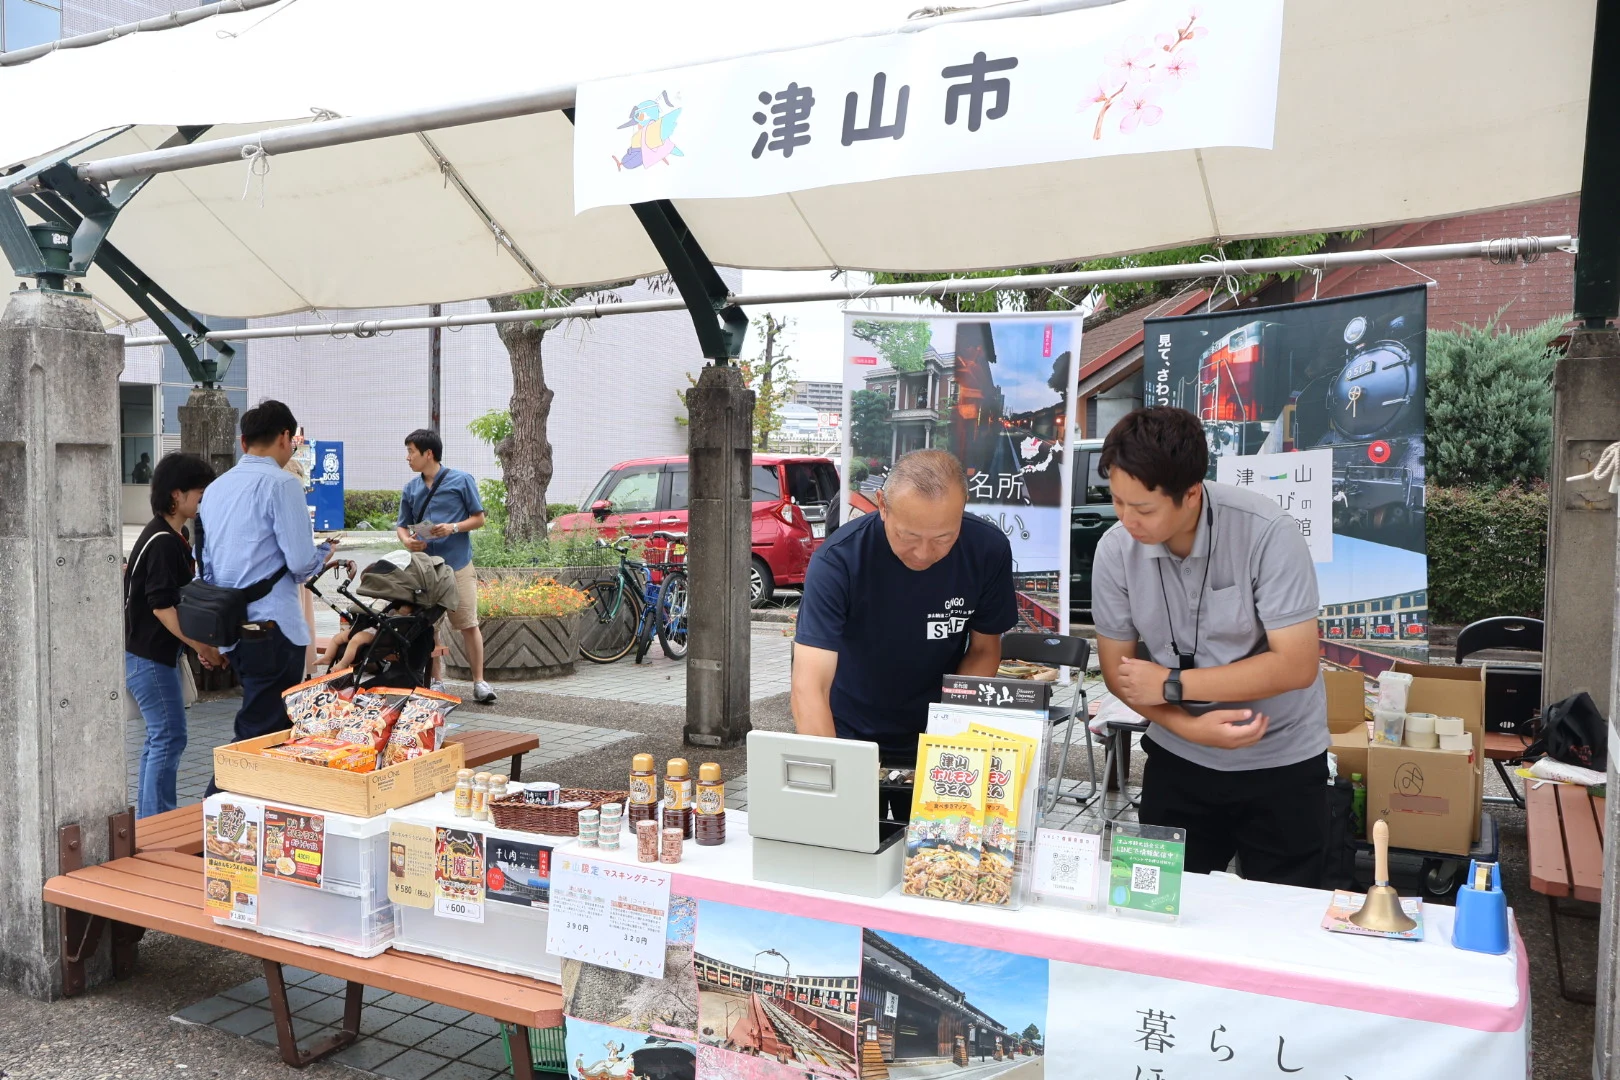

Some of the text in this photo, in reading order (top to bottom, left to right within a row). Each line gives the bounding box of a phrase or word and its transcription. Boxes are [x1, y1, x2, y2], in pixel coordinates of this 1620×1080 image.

[751, 52, 1018, 159] 津山市
[323, 473, 340, 481] BOSS
[978, 683, 1014, 706] 津山
[940, 754, 968, 770] 津山
[930, 768, 978, 785] ホルモン
[934, 783, 972, 798] うどん
[374, 803, 387, 811] 2014
[440, 855, 480, 878] 牛魔王
[562, 860, 666, 887] 津山限定 マスキングテープ
[1134, 1008, 1304, 1073] 暮らし
